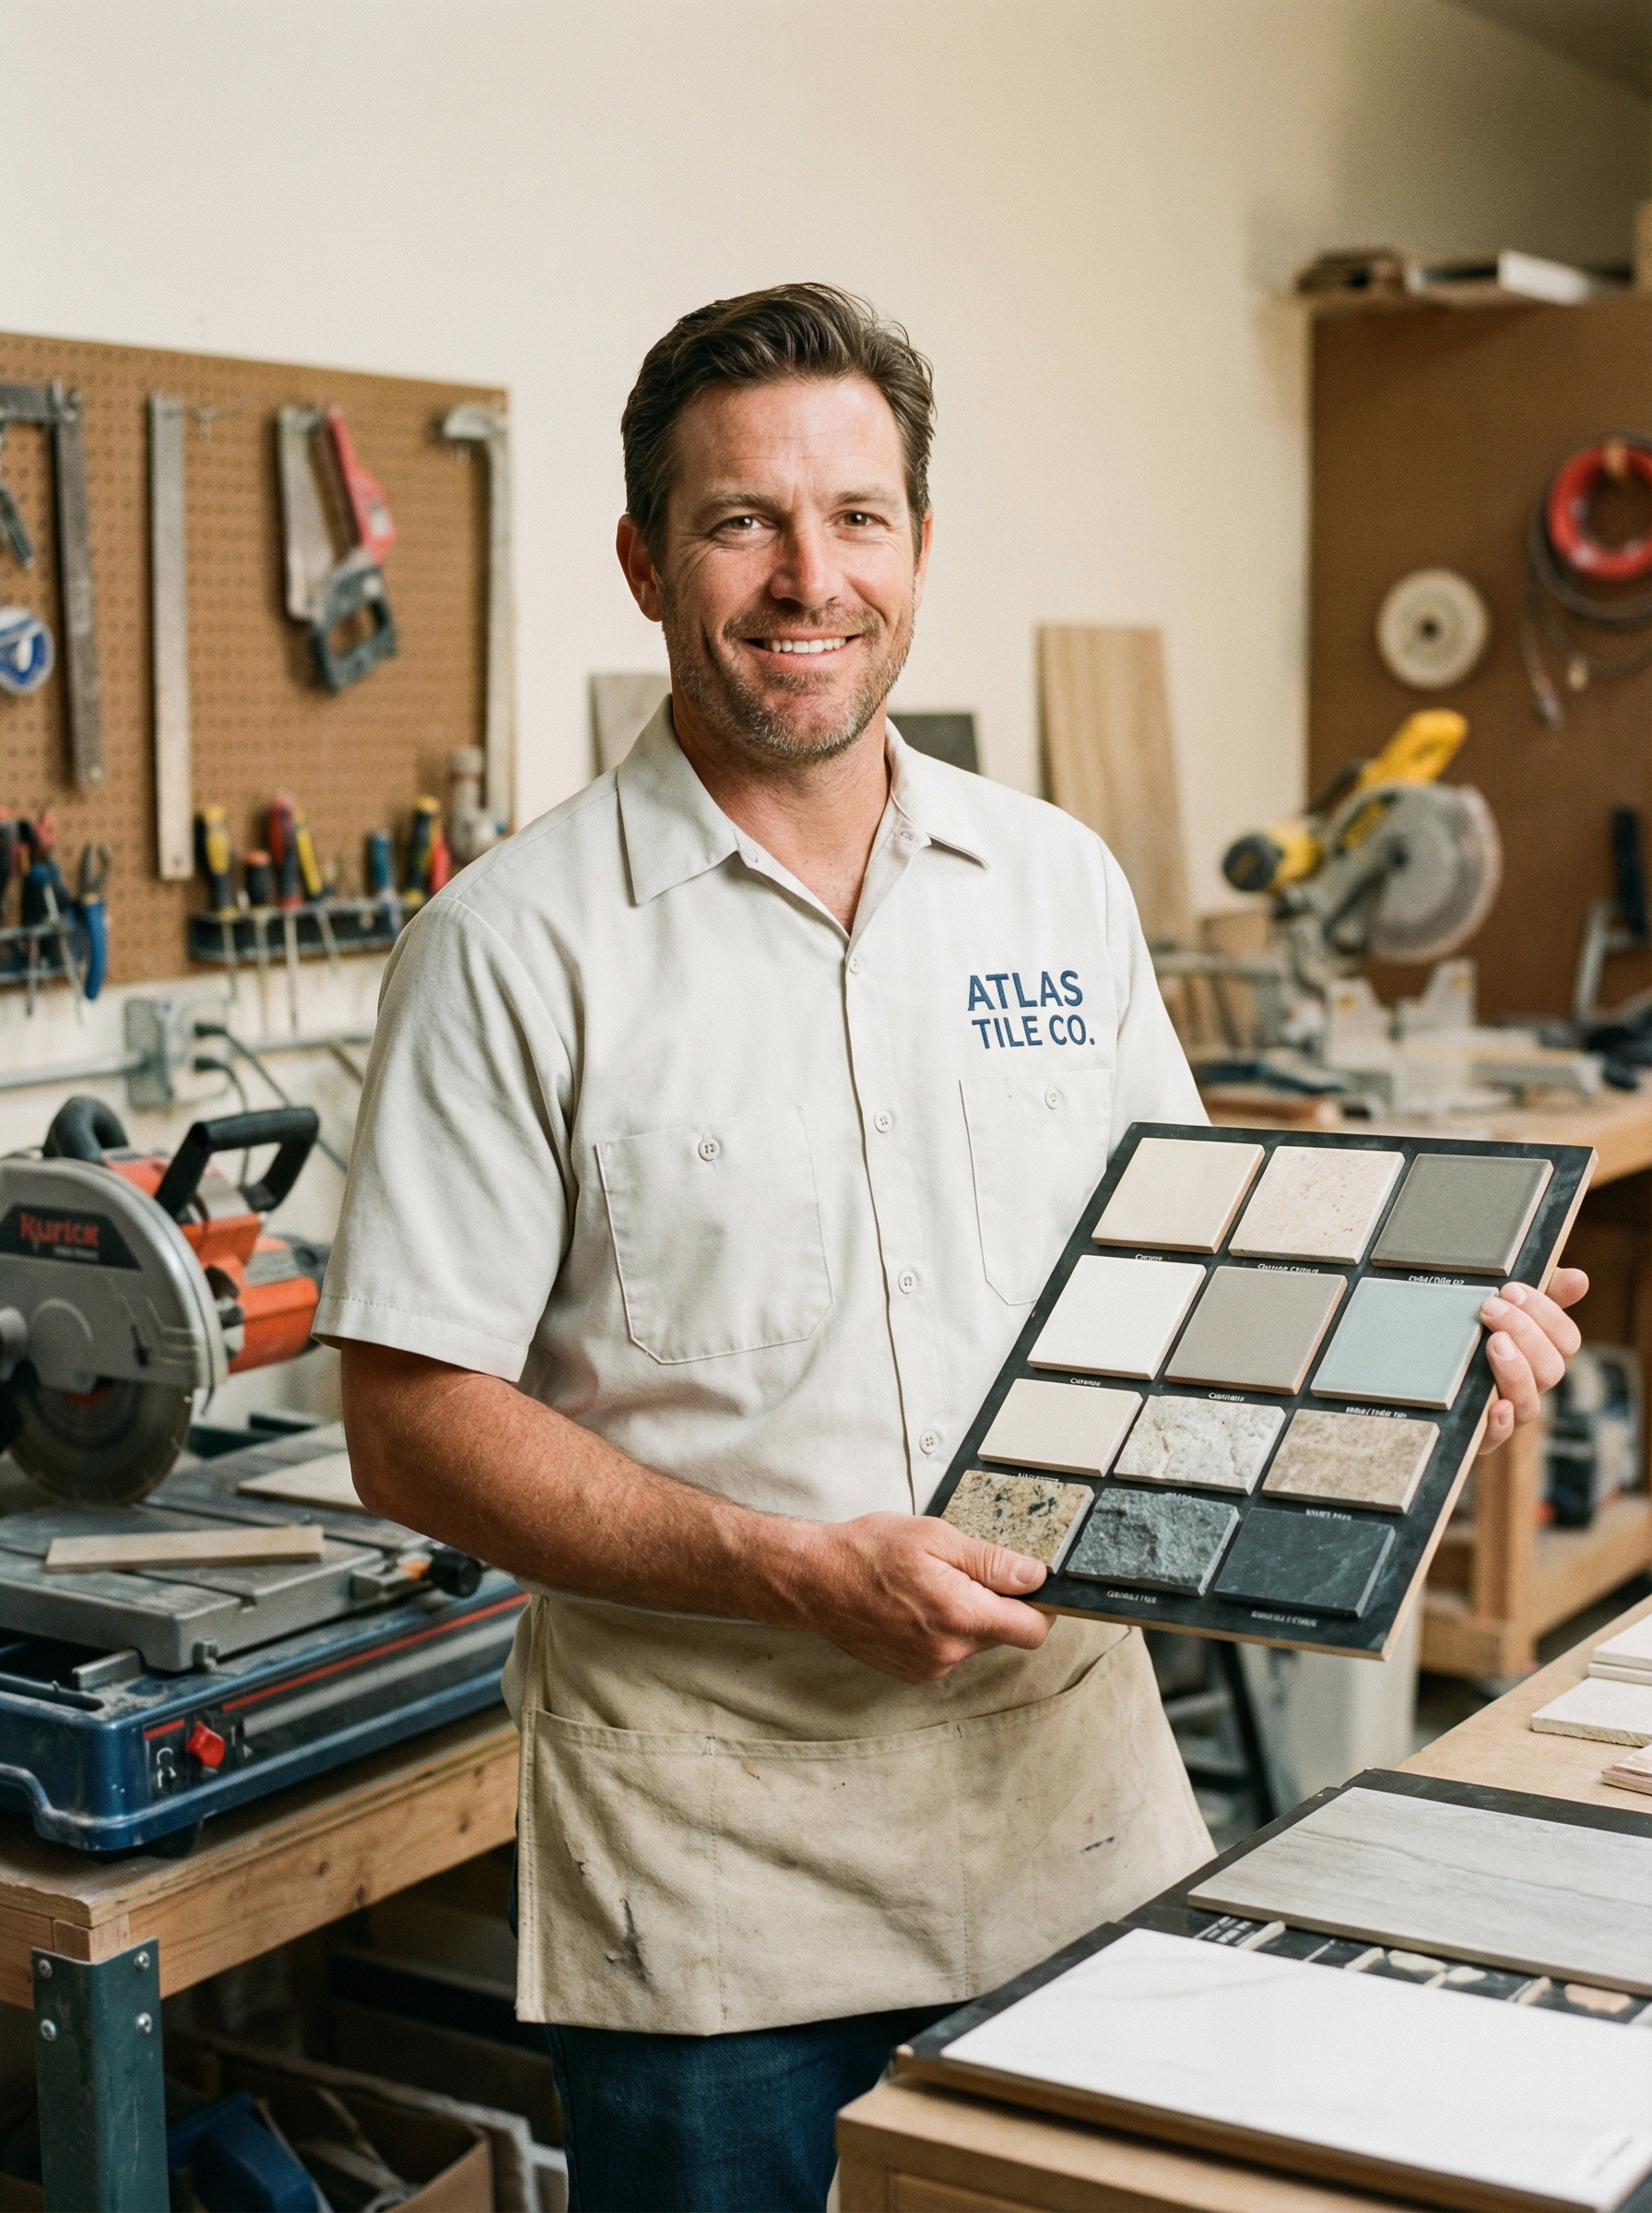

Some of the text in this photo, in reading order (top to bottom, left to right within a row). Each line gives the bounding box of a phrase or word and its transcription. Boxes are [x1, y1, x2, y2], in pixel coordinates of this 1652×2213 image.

[967, 970, 1083, 1011] ATLAS
[971, 1014, 1095, 1049] TILE CO.
